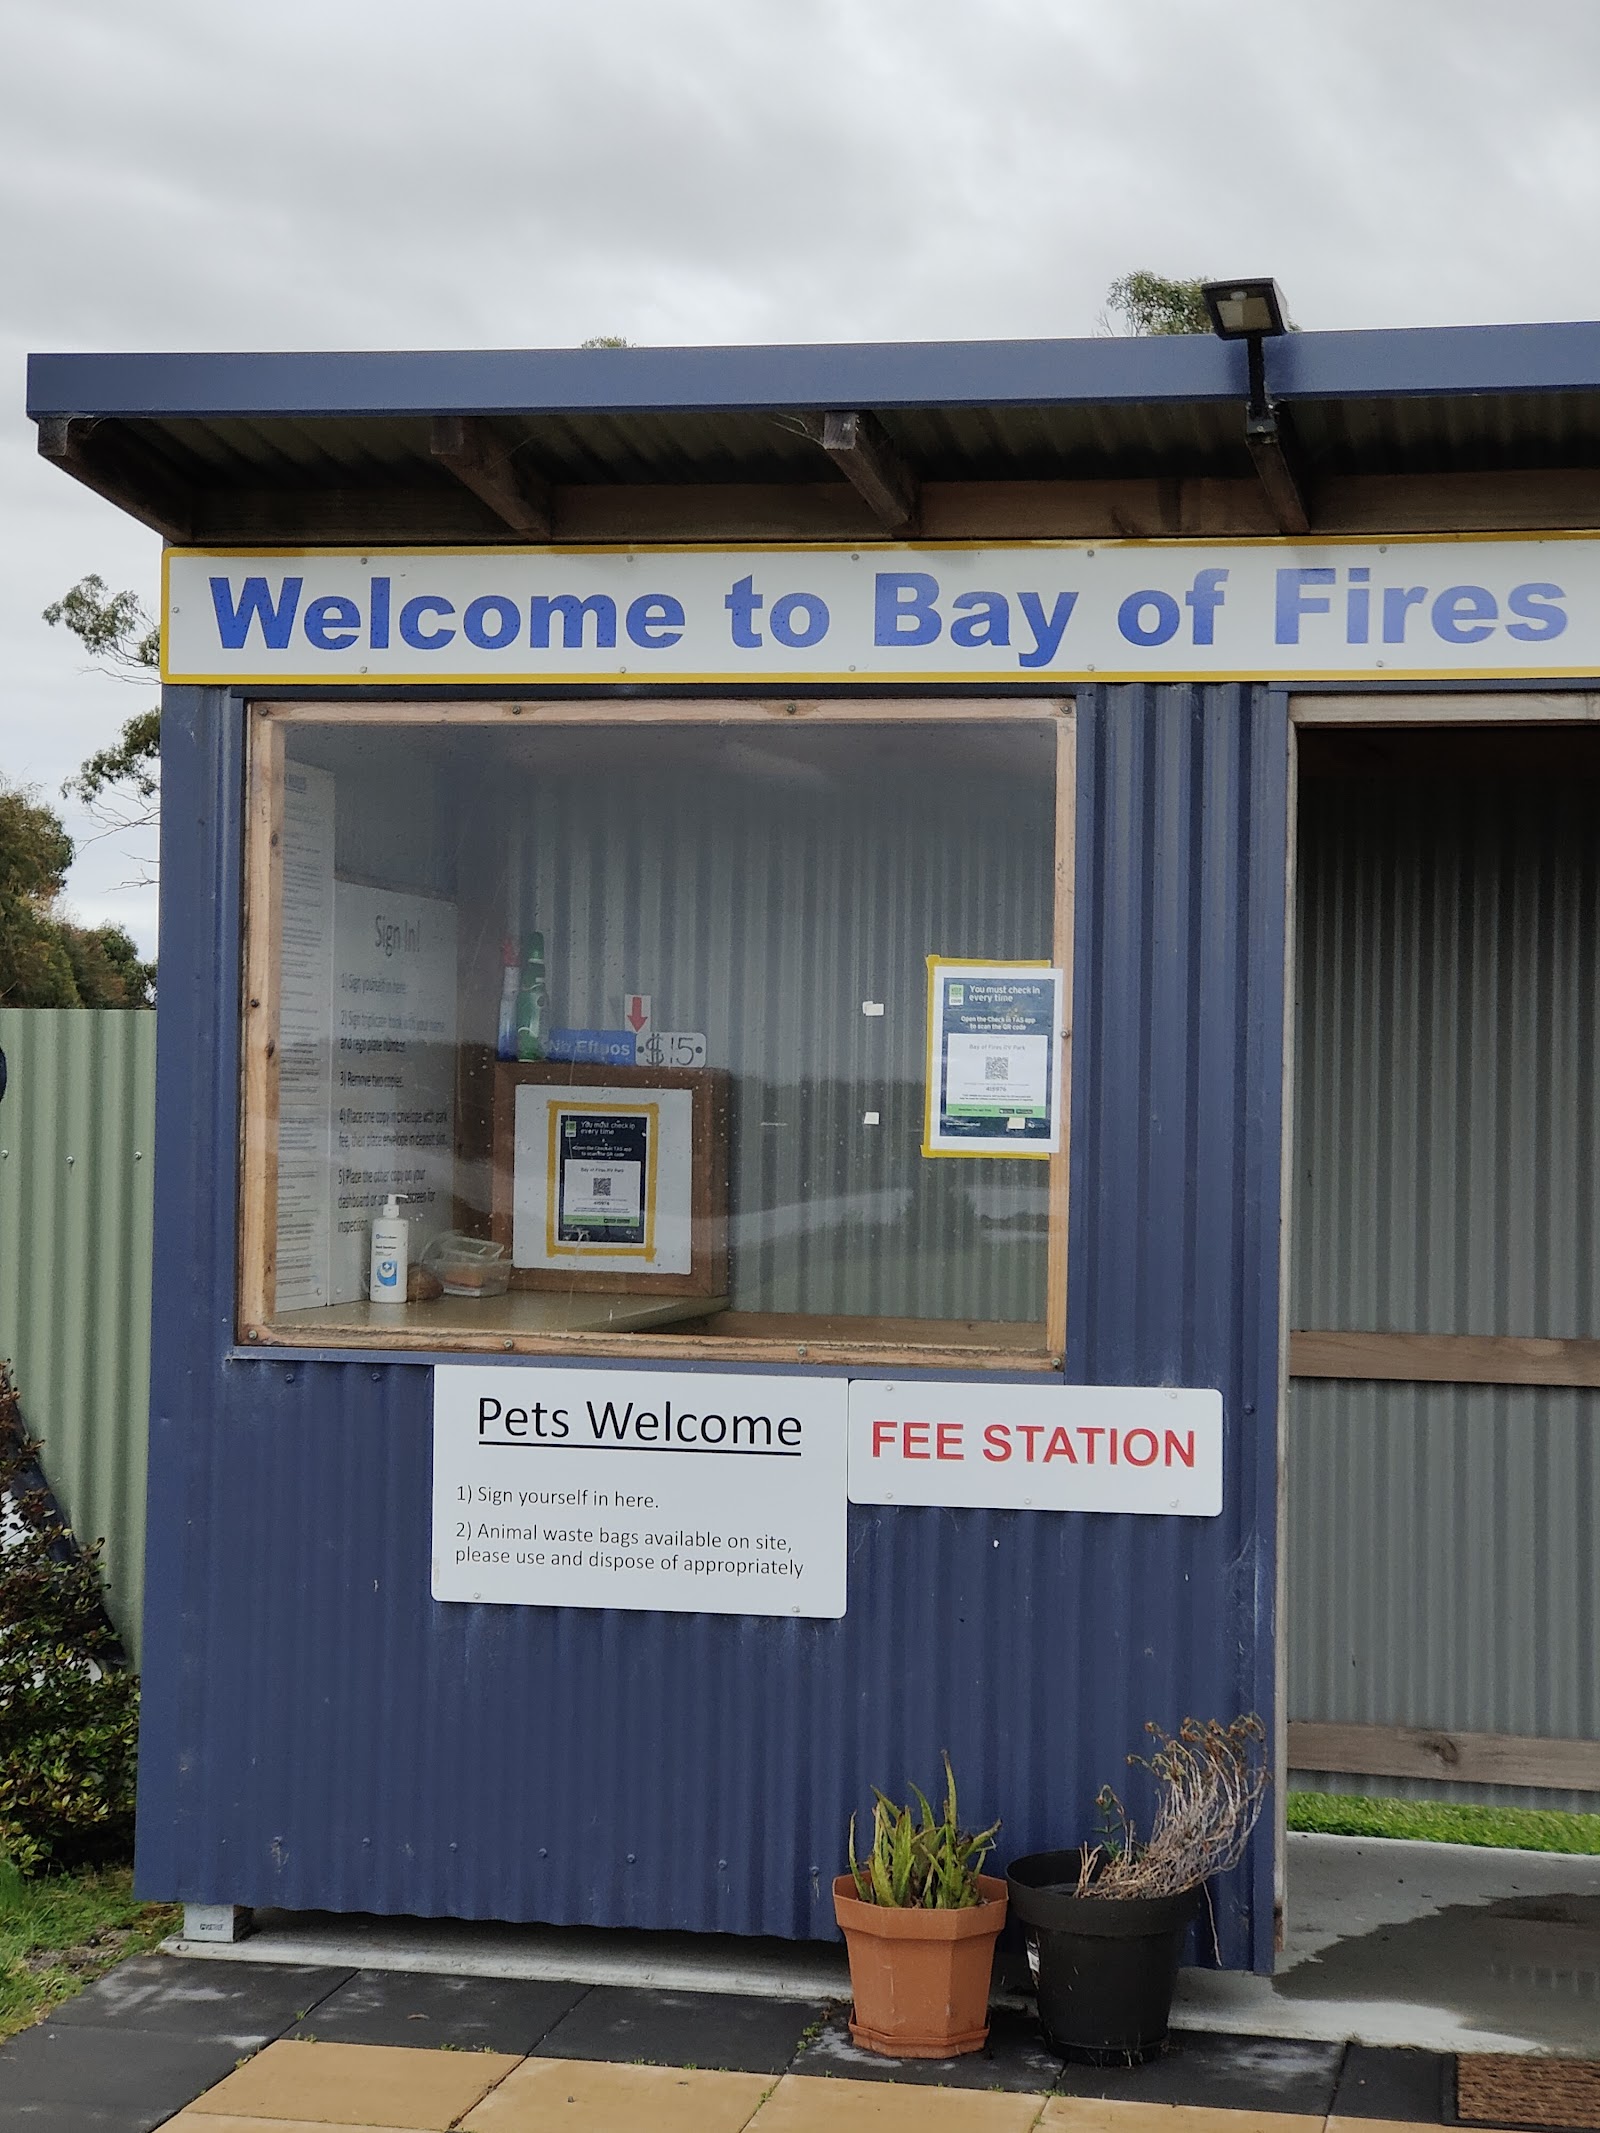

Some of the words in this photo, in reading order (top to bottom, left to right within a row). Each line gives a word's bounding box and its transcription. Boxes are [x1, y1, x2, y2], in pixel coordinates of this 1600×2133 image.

[208, 575, 686, 651] Welcome
[724, 573, 831, 649] to
[873, 572, 1080, 668] Bay
[1116, 568, 1230, 647] of
[1274, 566, 1568, 645] Fires
[375, 915, 401, 957] Sign
[968, 994, 993, 1004] every
[994, 994, 1014, 1003] time
[969, 985, 985, 994] You
[986, 985, 1007, 994] must
[1007, 985, 1031, 994] check
[1032, 985, 1041, 995] in
[478, 1397, 570, 1438] Pets
[585, 1400, 803, 1447] Welcome
[872, 1420, 965, 1462] FEE
[982, 1423, 1196, 1468] STATION
[456, 1484, 473, 1505] 1)
[477, 1485, 514, 1507] Sign
[518, 1485, 588, 1509] yourself
[592, 1488, 609, 1508] in
[614, 1490, 660, 1510] here.
[455, 1521, 472, 1542] 2)
[477, 1522, 538, 1543] Animal
[543, 1526, 594, 1545] waste
[599, 1527, 640, 1548] bags
[644, 1529, 722, 1550] available
[727, 1535, 750, 1551] on
[755, 1532, 793, 1555] site,
[455, 1545, 511, 1566] please
[515, 1551, 545, 1567] use
[550, 1549, 583, 1569] and
[588, 1551, 656, 1574] dispose
[660, 1553, 679, 1571] of
[683, 1556, 805, 1580] appropriately
